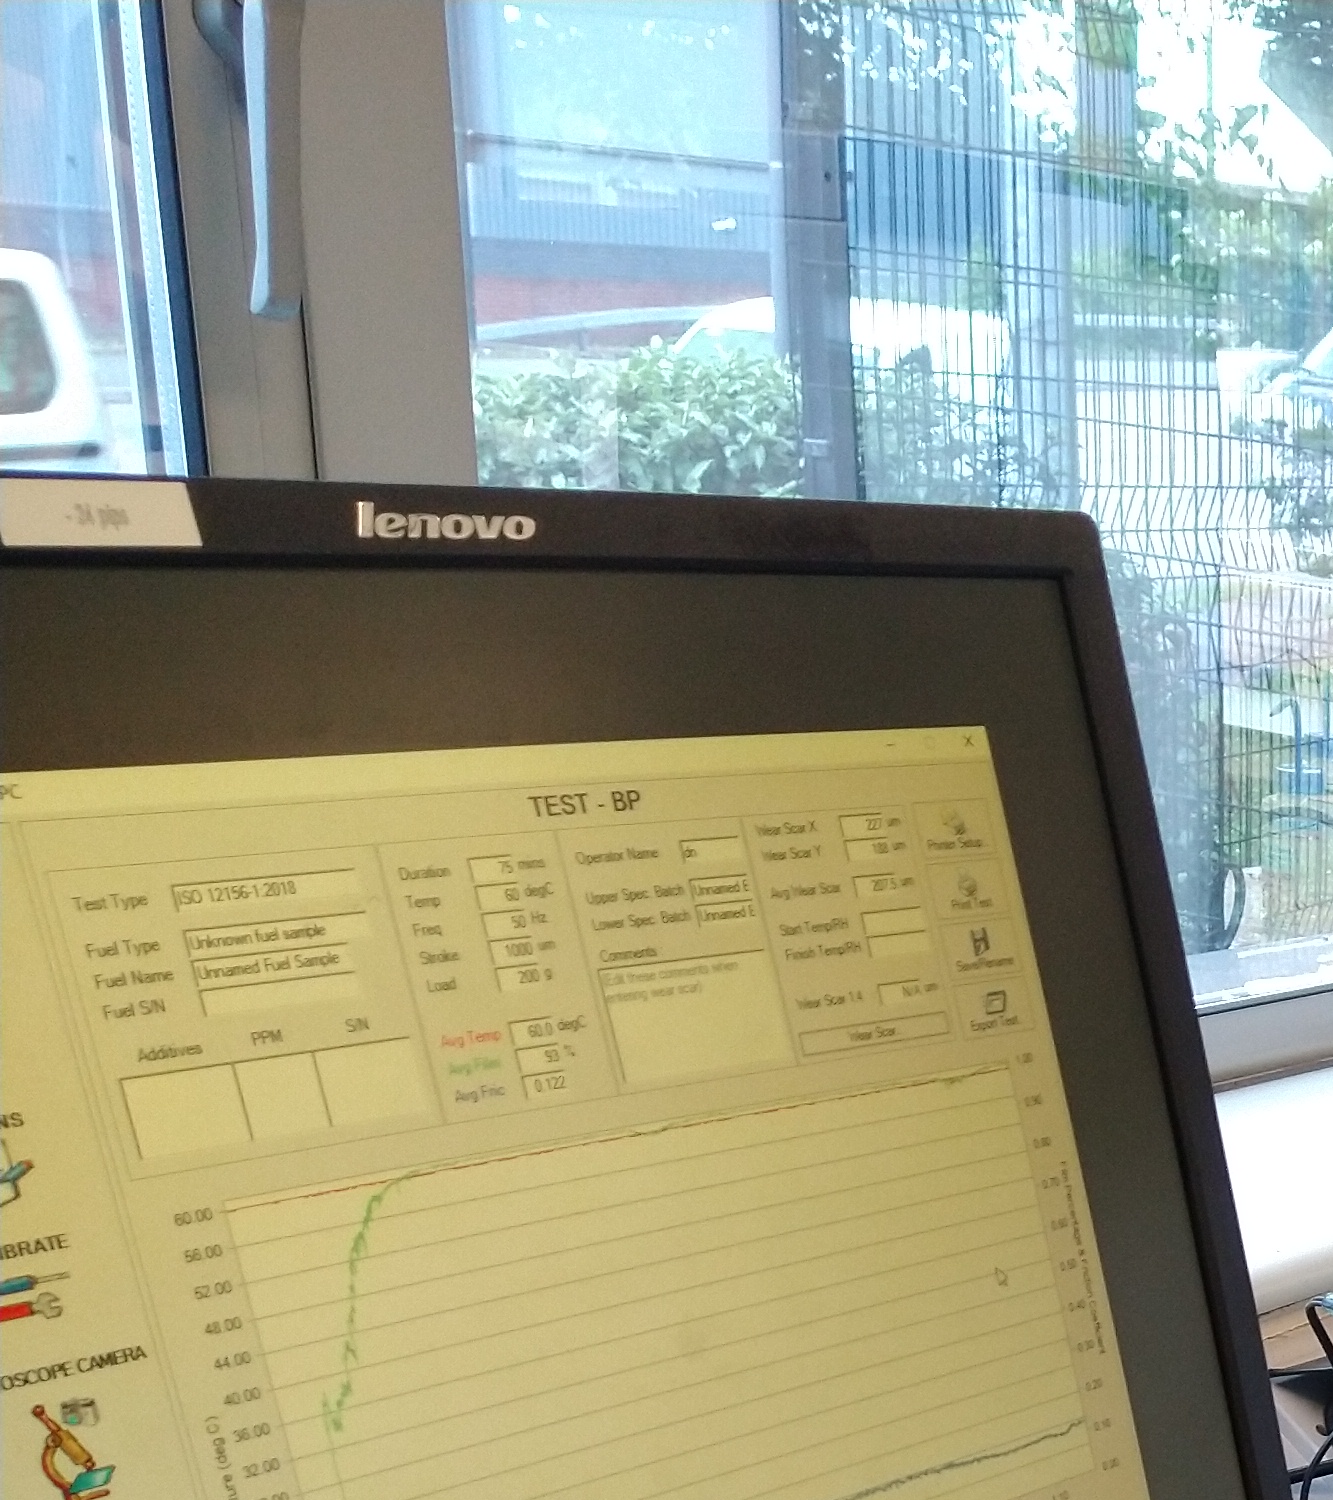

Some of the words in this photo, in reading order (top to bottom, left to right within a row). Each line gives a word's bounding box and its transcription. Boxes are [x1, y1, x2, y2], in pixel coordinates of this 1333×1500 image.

[356, 500, 537, 542] lenovo
[528, 793, 588, 818] TEST
[611, 790, 642, 812] BP
[575, 848, 624, 866] Operator
[627, 847, 659, 860] Name
[398, 865, 451, 881] Duration
[653, 883, 685, 899] Batch
[72, 896, 108, 913] Test
[110, 893, 149, 911] Type
[175, 888, 204, 906] ISO
[404, 894, 441, 909] Temp
[660, 909, 691, 925] Batch
[412, 922, 443, 938] Freq
[86, 942, 119, 959] Fuel
[122, 939, 161, 959] Type
[191, 932, 253, 950] Unknown
[254, 927, 279, 944] fuel
[281, 923, 327, 942] sample
[419, 949, 460, 966] Stroke
[94, 972, 130, 990] Fuel
[132, 969, 174, 985] Name
[198, 961, 260, 980] Unnamed
[264, 957, 292, 973] Fuel
[295, 952, 340, 970] Sample
[426, 976, 457, 993] Load
[102, 1003, 135, 1020] Fuel
[467, 1028, 501, 1044] Temp
[138, 1043, 204, 1063] Additives
[251, 1028, 284, 1046] PPM
[77, 1344, 148, 1374] CAMERA
